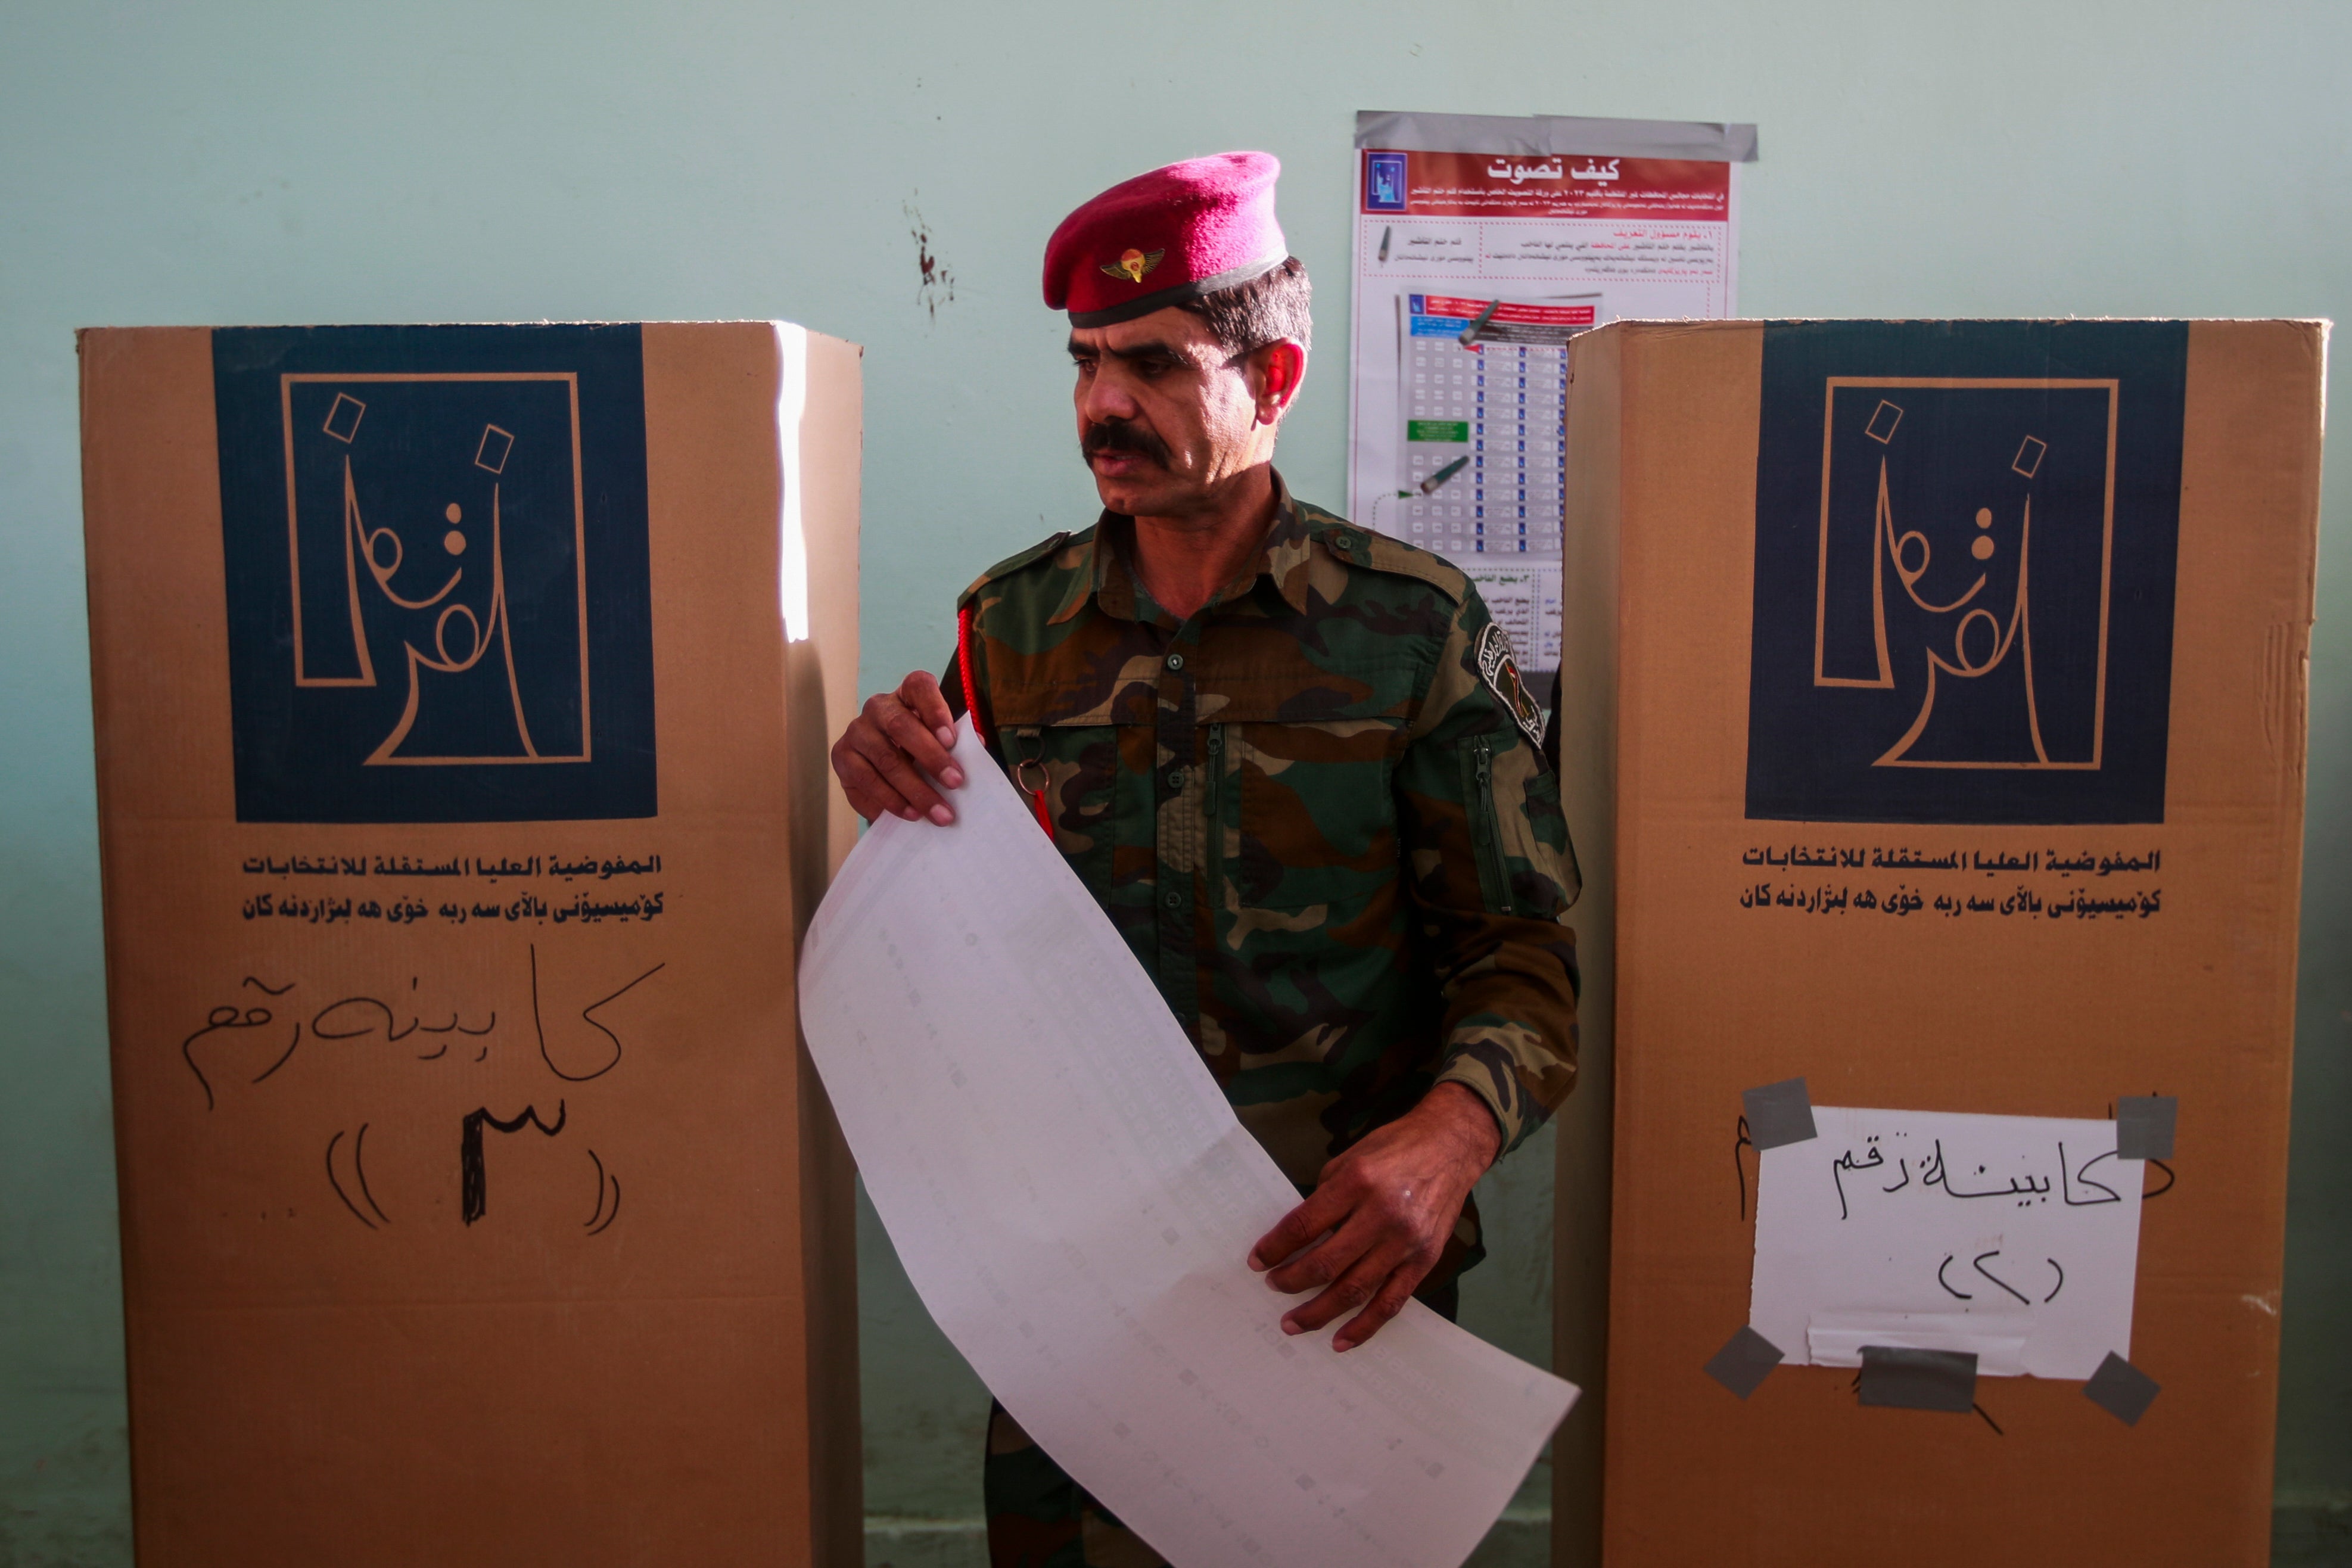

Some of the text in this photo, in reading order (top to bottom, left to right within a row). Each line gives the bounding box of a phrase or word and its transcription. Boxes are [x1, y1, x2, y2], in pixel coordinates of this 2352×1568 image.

[1487, 157, 1620, 187] كيف تصوت
[242, 854, 661, 883] المفوضية العليا المستقلة للانتخابات
[1742, 845, 2160, 877] المفوضية العليا المستقلة للانتخابات
[183, 976, 301, 1111] رقم
[1833, 1131, 1910, 1220] رقم
